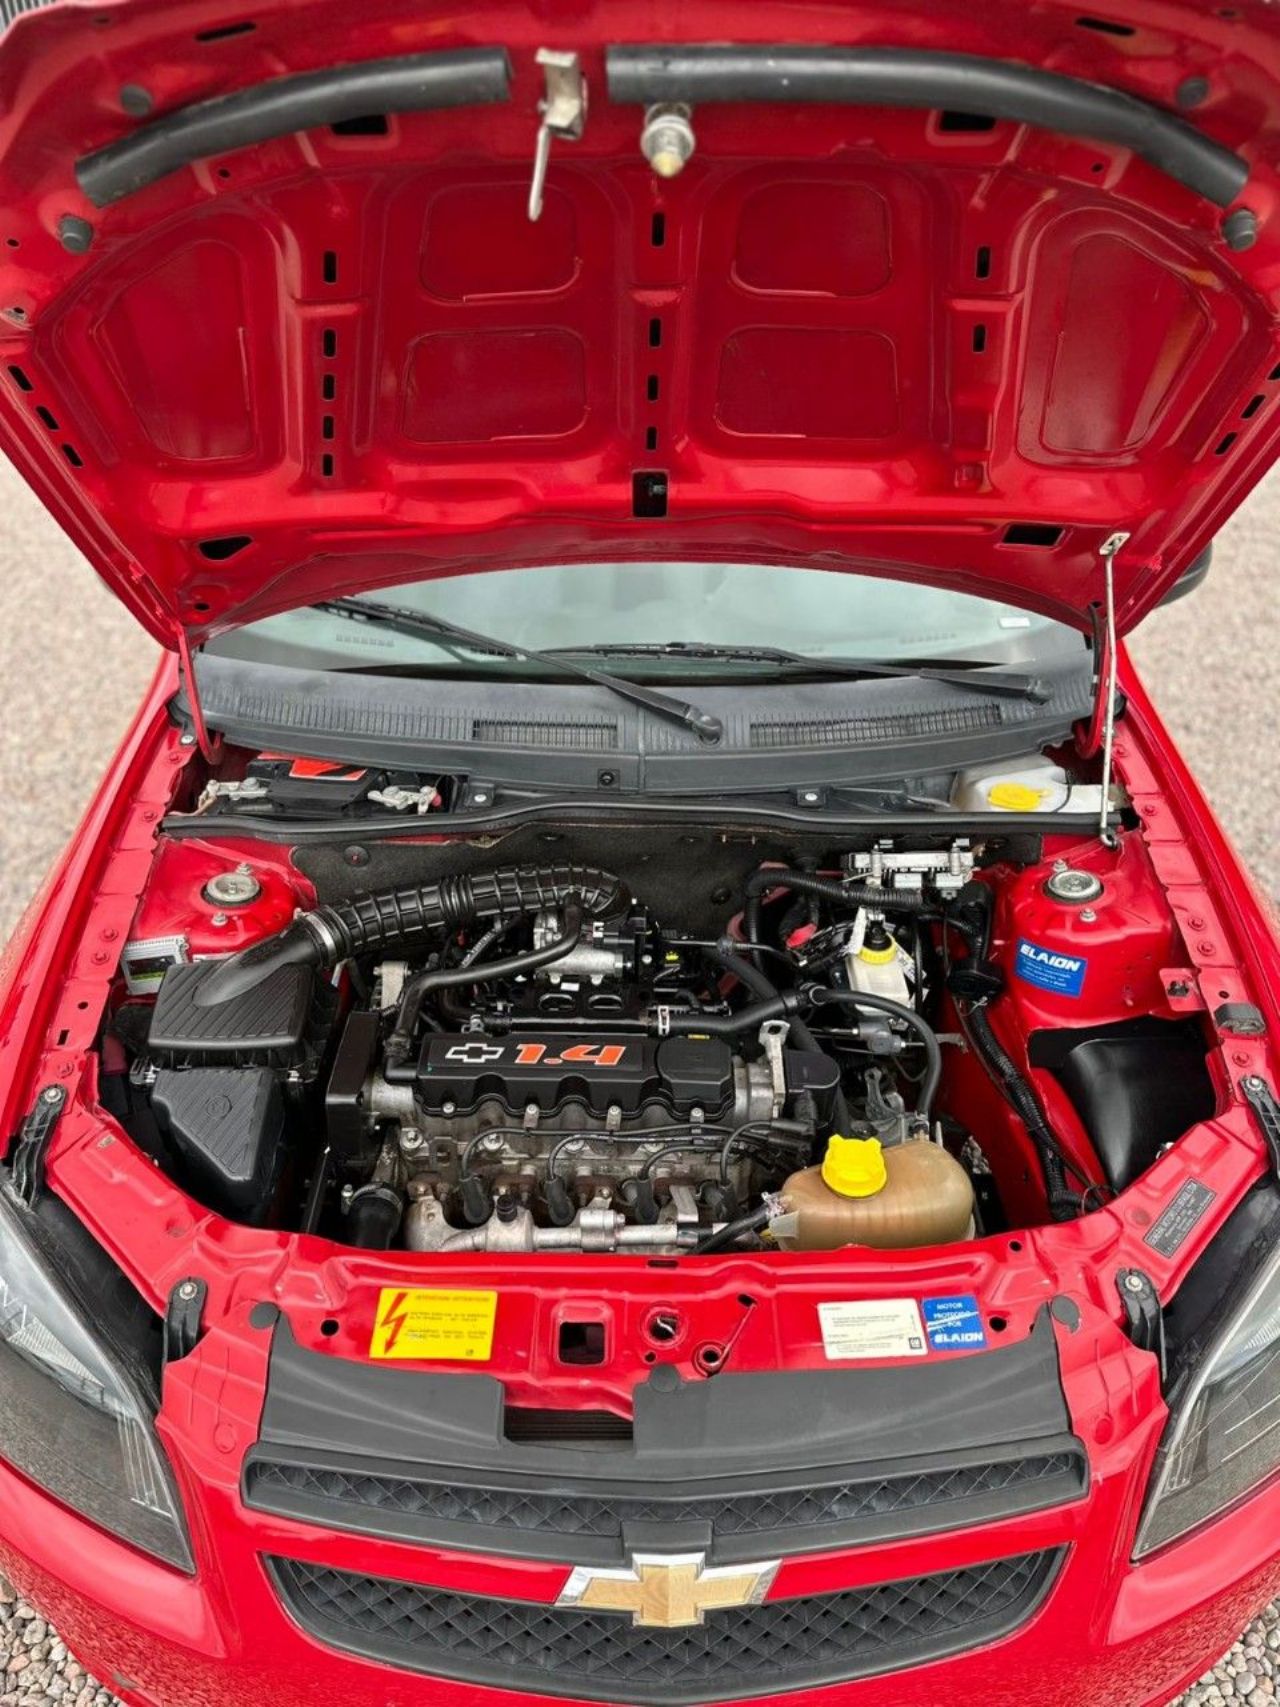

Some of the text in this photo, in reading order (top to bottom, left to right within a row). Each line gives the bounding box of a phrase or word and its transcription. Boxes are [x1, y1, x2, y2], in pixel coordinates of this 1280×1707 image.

[1020, 943, 1082, 972] ELAION
[514, 1043, 627, 1065] 1.4
[936, 1302, 963, 1310] MOTOR
[934, 1331, 984, 1344] ELAION
